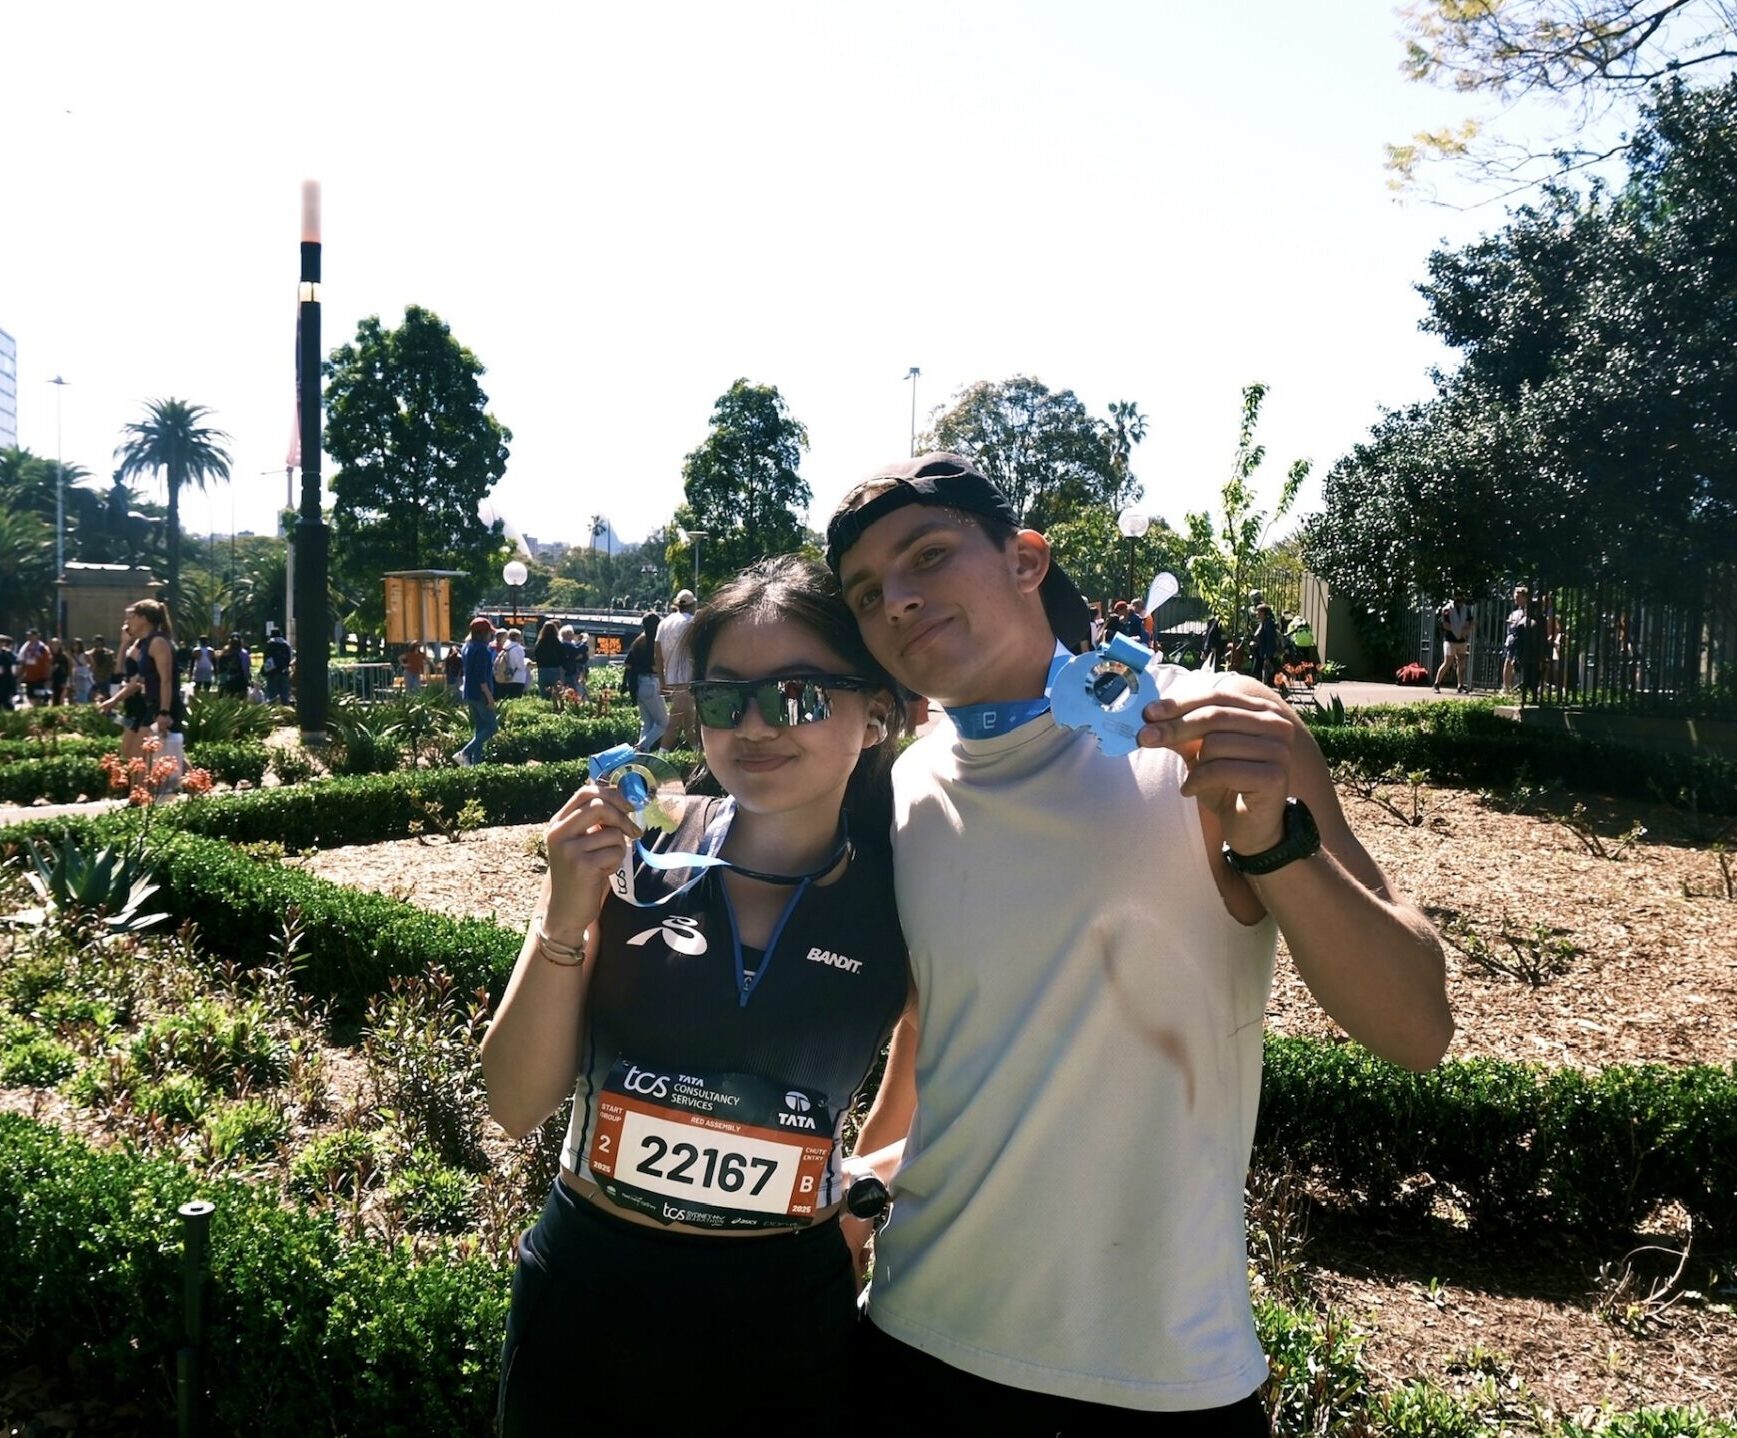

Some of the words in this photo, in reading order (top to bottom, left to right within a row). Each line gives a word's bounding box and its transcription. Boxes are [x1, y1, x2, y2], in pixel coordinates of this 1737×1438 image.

[623, 1065, 671, 1099] tcs
[678, 1074, 704, 1087] TATA
[671, 1093, 714, 1111] SERVICES
[673, 1083, 740, 1106] CONSULTANCY
[600, 1112, 622, 1123] GROUP
[601, 1103, 624, 1115] START
[690, 1116, 705, 1126] RED
[705, 1121, 741, 1132] ASSEMBLY
[778, 1112, 816, 1130] TATA
[598, 1134, 611, 1153] 2
[593, 1160, 611, 1173] 2025
[636, 1135, 778, 1196] 22167
[799, 1175, 814, 1193] B
[662, 1202, 686, 1221] tcs
[791, 1205, 812, 1214] 2025
